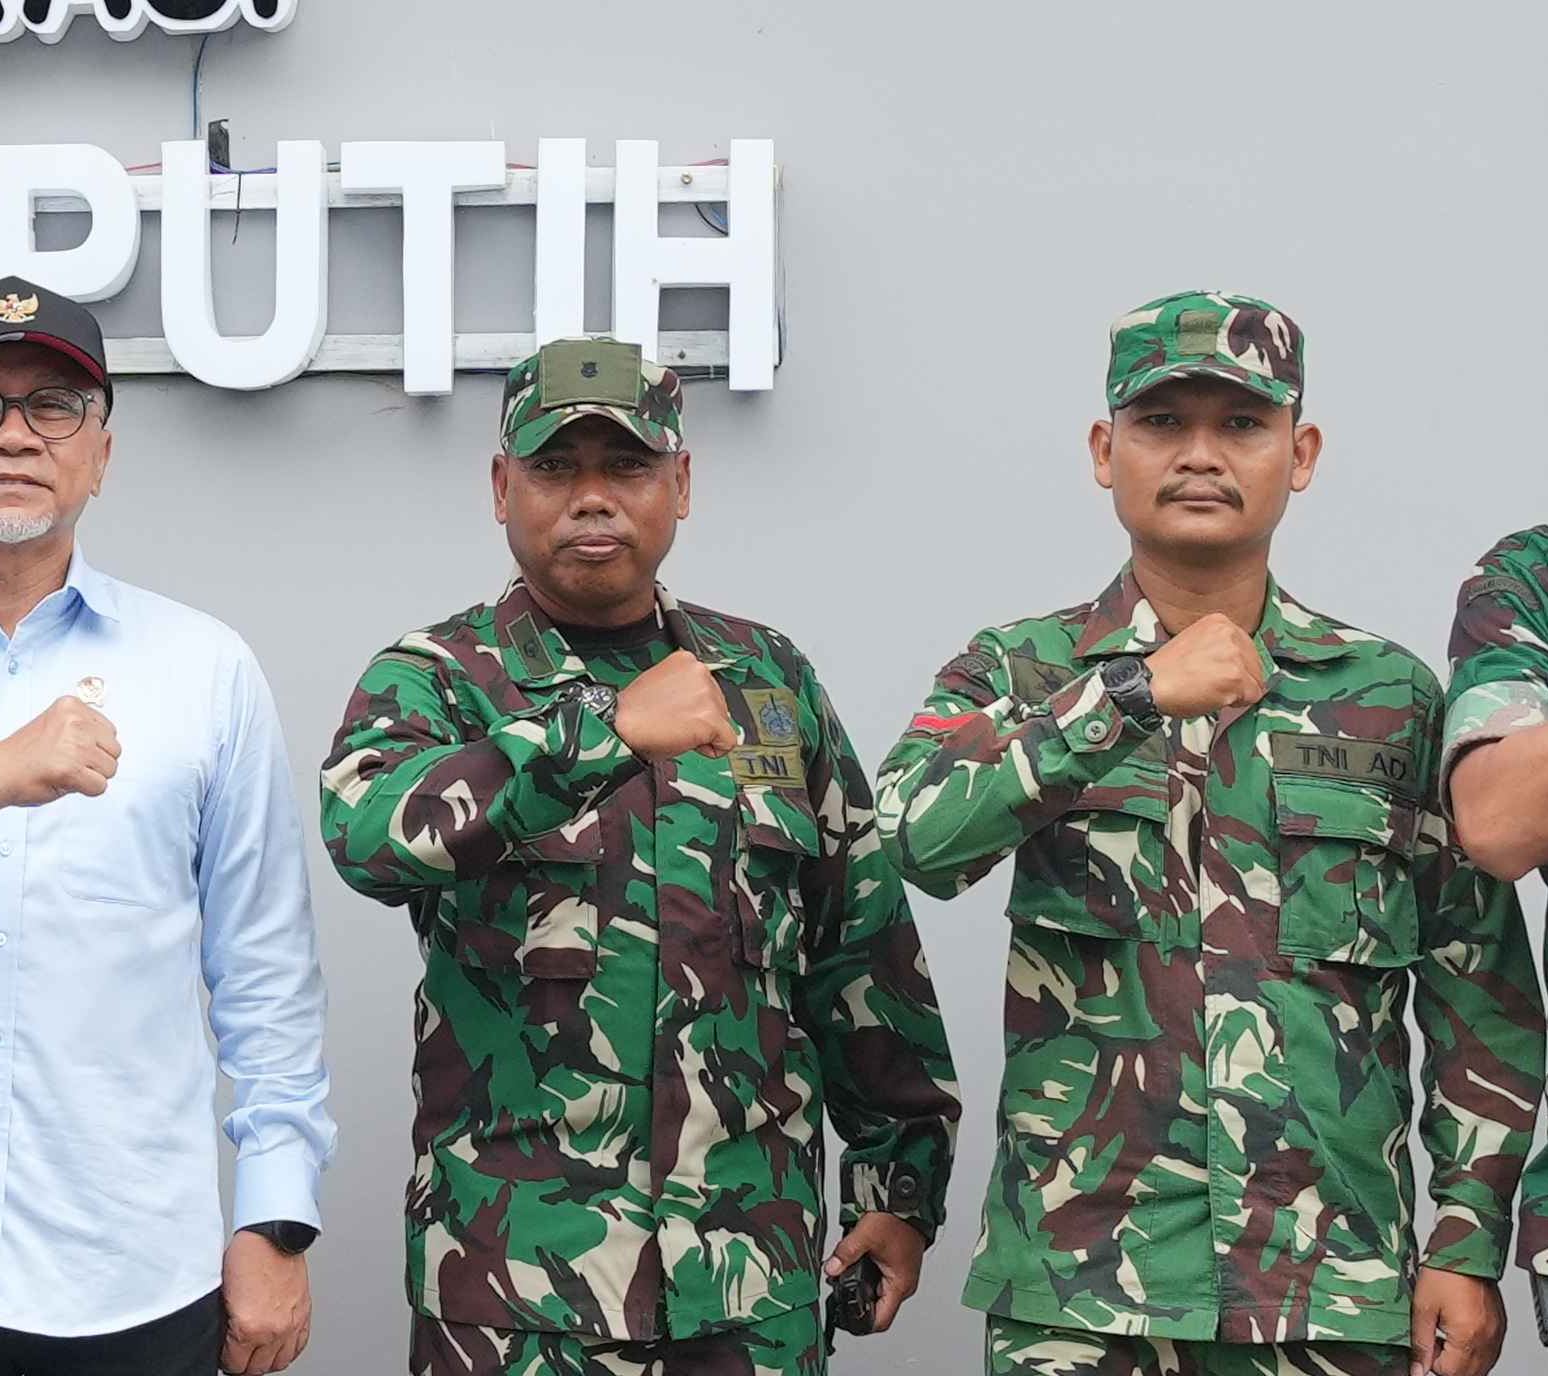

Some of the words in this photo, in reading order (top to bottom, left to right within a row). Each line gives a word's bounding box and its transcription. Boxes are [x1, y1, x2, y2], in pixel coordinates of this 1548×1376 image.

[741, 756, 791, 779] TNI
[1295, 745, 1350, 771] TNI
[1368, 752, 1408, 781] AD
